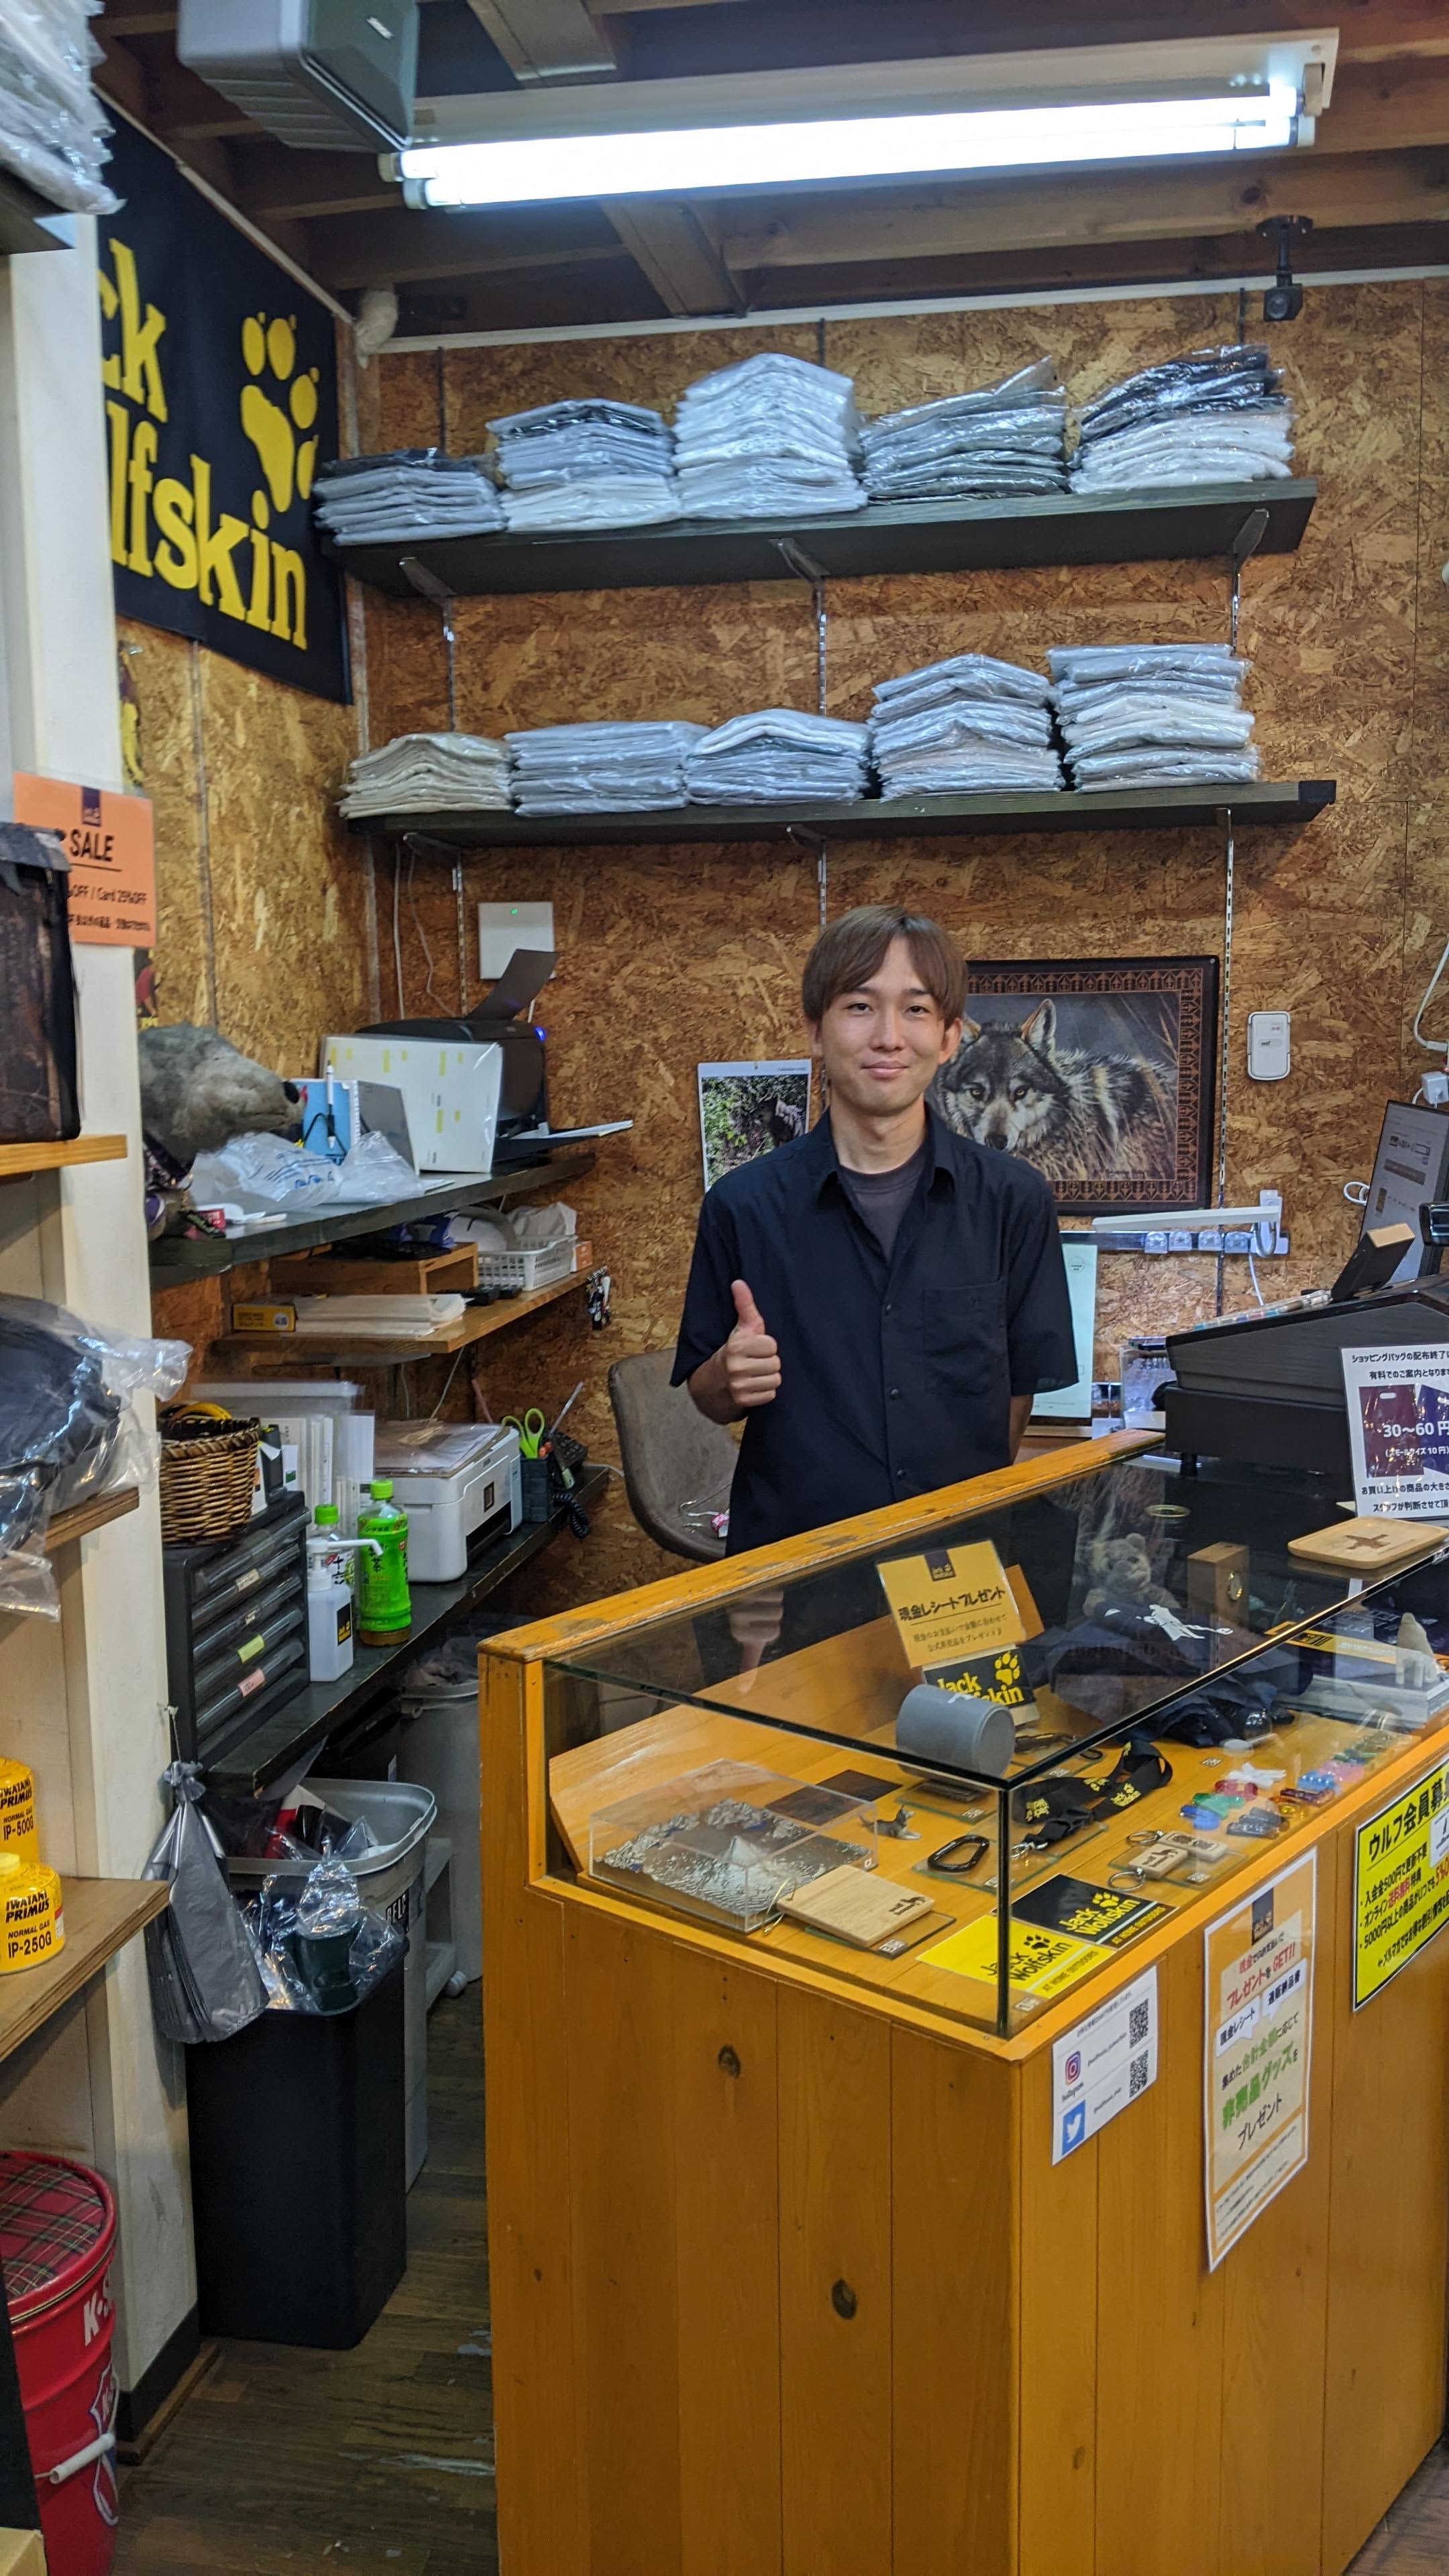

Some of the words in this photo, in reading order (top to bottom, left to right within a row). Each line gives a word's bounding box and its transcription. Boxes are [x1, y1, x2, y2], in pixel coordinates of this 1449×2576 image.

[70, 828, 114, 862] SALE
[898, 1586, 1005, 1621] 現金レシートプレゼント
[0, 1787, 32, 1810] PRIMUS
[3, 1813, 25, 1824] NORMAL
[5, 1898, 50, 1923] PRIMUS
[6, 1889, 48, 1911] IWATANI
[8, 1925, 38, 1939] NORMAL
[39, 1919, 50, 1932] GAS
[1059, 1907, 1100, 1931] Jack
[1074, 1898, 1142, 1936] Wolfskin
[7, 1931, 52, 1959] IP-250G
[1237, 2092, 1283, 2151] プレゼント
